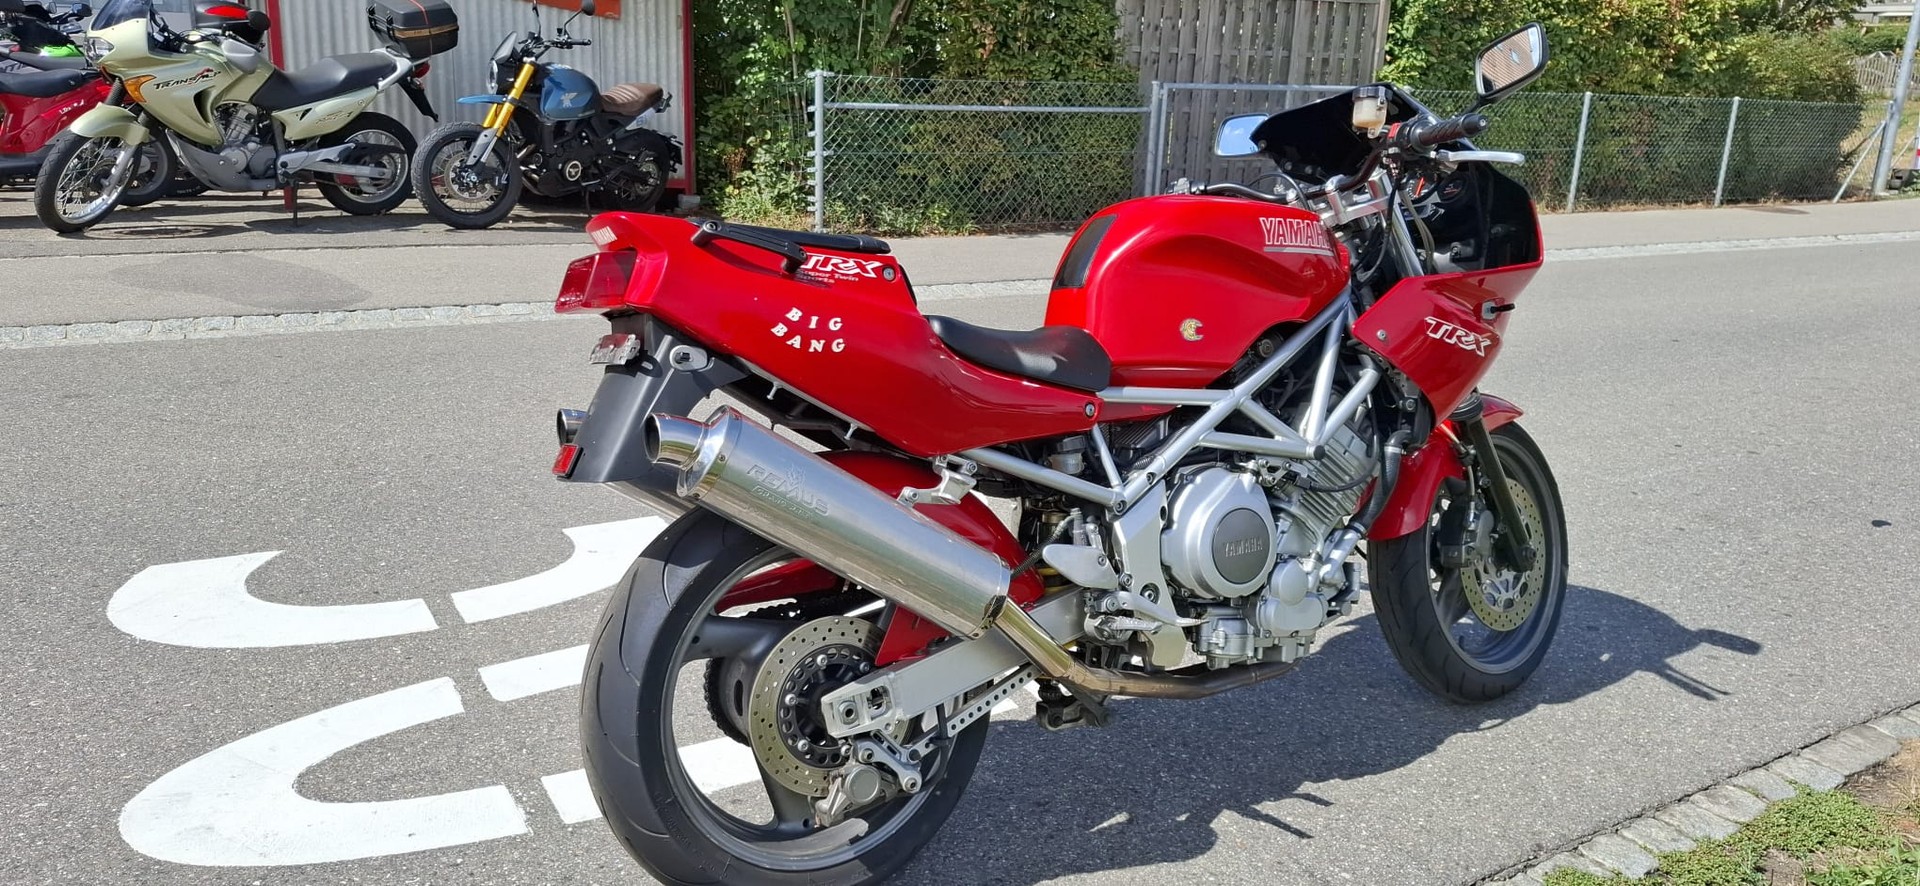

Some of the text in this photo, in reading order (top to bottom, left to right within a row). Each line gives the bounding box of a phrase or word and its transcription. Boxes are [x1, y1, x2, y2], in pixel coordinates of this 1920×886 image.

[1259, 217, 1332, 249] YAMAH
[800, 252, 883, 278] TRX
[784, 306, 843, 331] BIG
[770, 322, 846, 353] BANG
[1424, 316, 1492, 357] TRX
[746, 464, 831, 517] REMUS
[1224, 537, 1264, 558] YAMAHA
